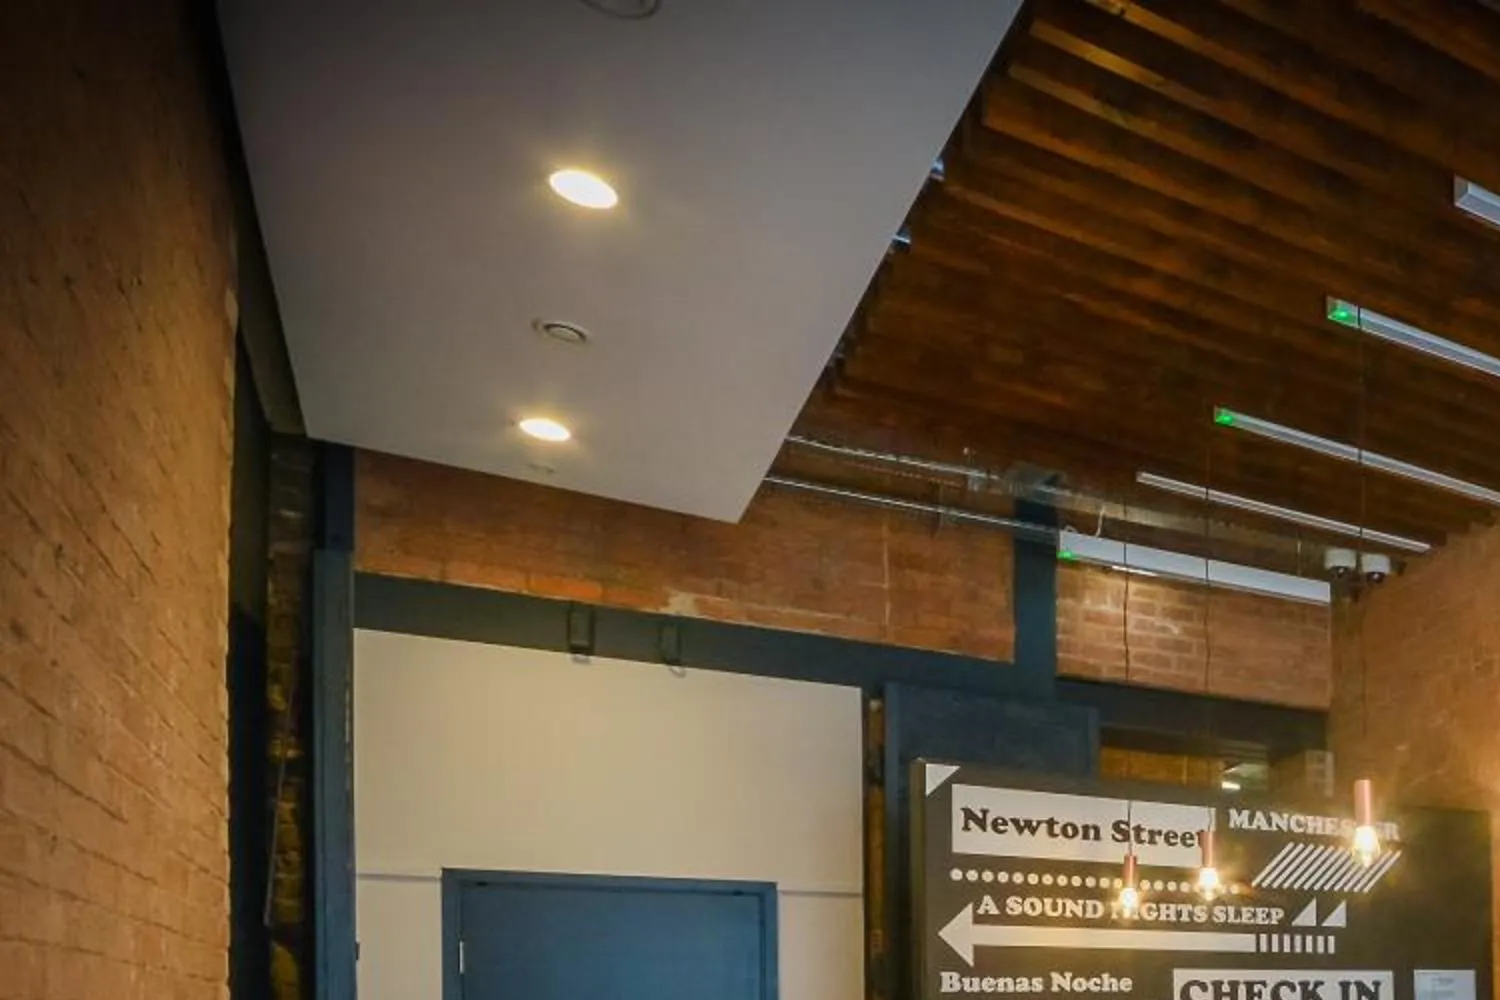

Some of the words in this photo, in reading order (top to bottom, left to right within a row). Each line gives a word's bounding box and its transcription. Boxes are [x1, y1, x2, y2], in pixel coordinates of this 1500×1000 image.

[961, 807, 1101, 841] Newton
[977, 895, 1000, 915] A
[1006, 896, 1104, 919] SOUND
[1212, 905, 1284, 924] SLEEP
[940, 971, 1044, 993] Buenas
[1050, 971, 1133, 993] Noche
